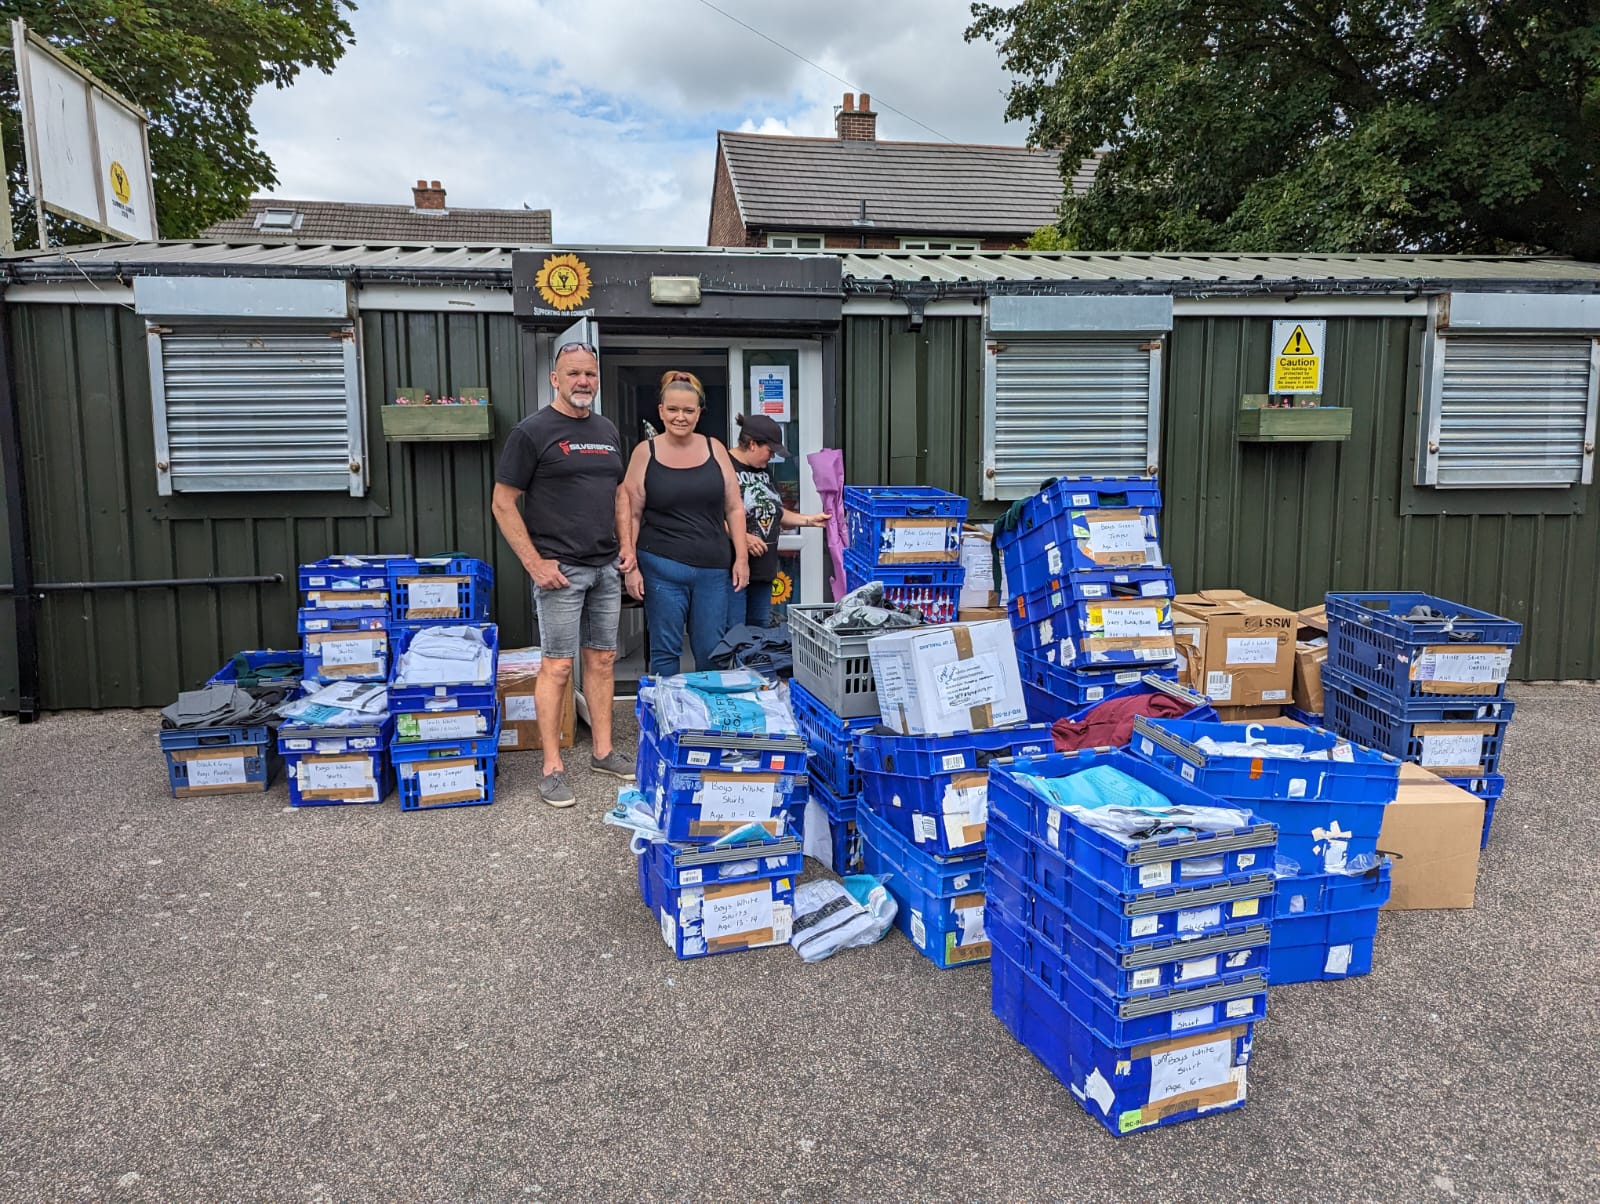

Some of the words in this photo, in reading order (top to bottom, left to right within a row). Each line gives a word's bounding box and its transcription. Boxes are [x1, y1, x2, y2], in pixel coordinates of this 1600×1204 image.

[1280, 358, 1315, 367] Caution
[711, 781, 733, 794] Boys
[742, 783, 765, 793] White
[709, 811, 724, 820] Age
[713, 904, 733, 914] Boys
[736, 897, 759, 907] White
[718, 923, 731, 932] Age
[1168, 1055, 1188, 1066] Boys
[1191, 1046, 1215, 1058] White
[1165, 1083, 1181, 1094] Age
